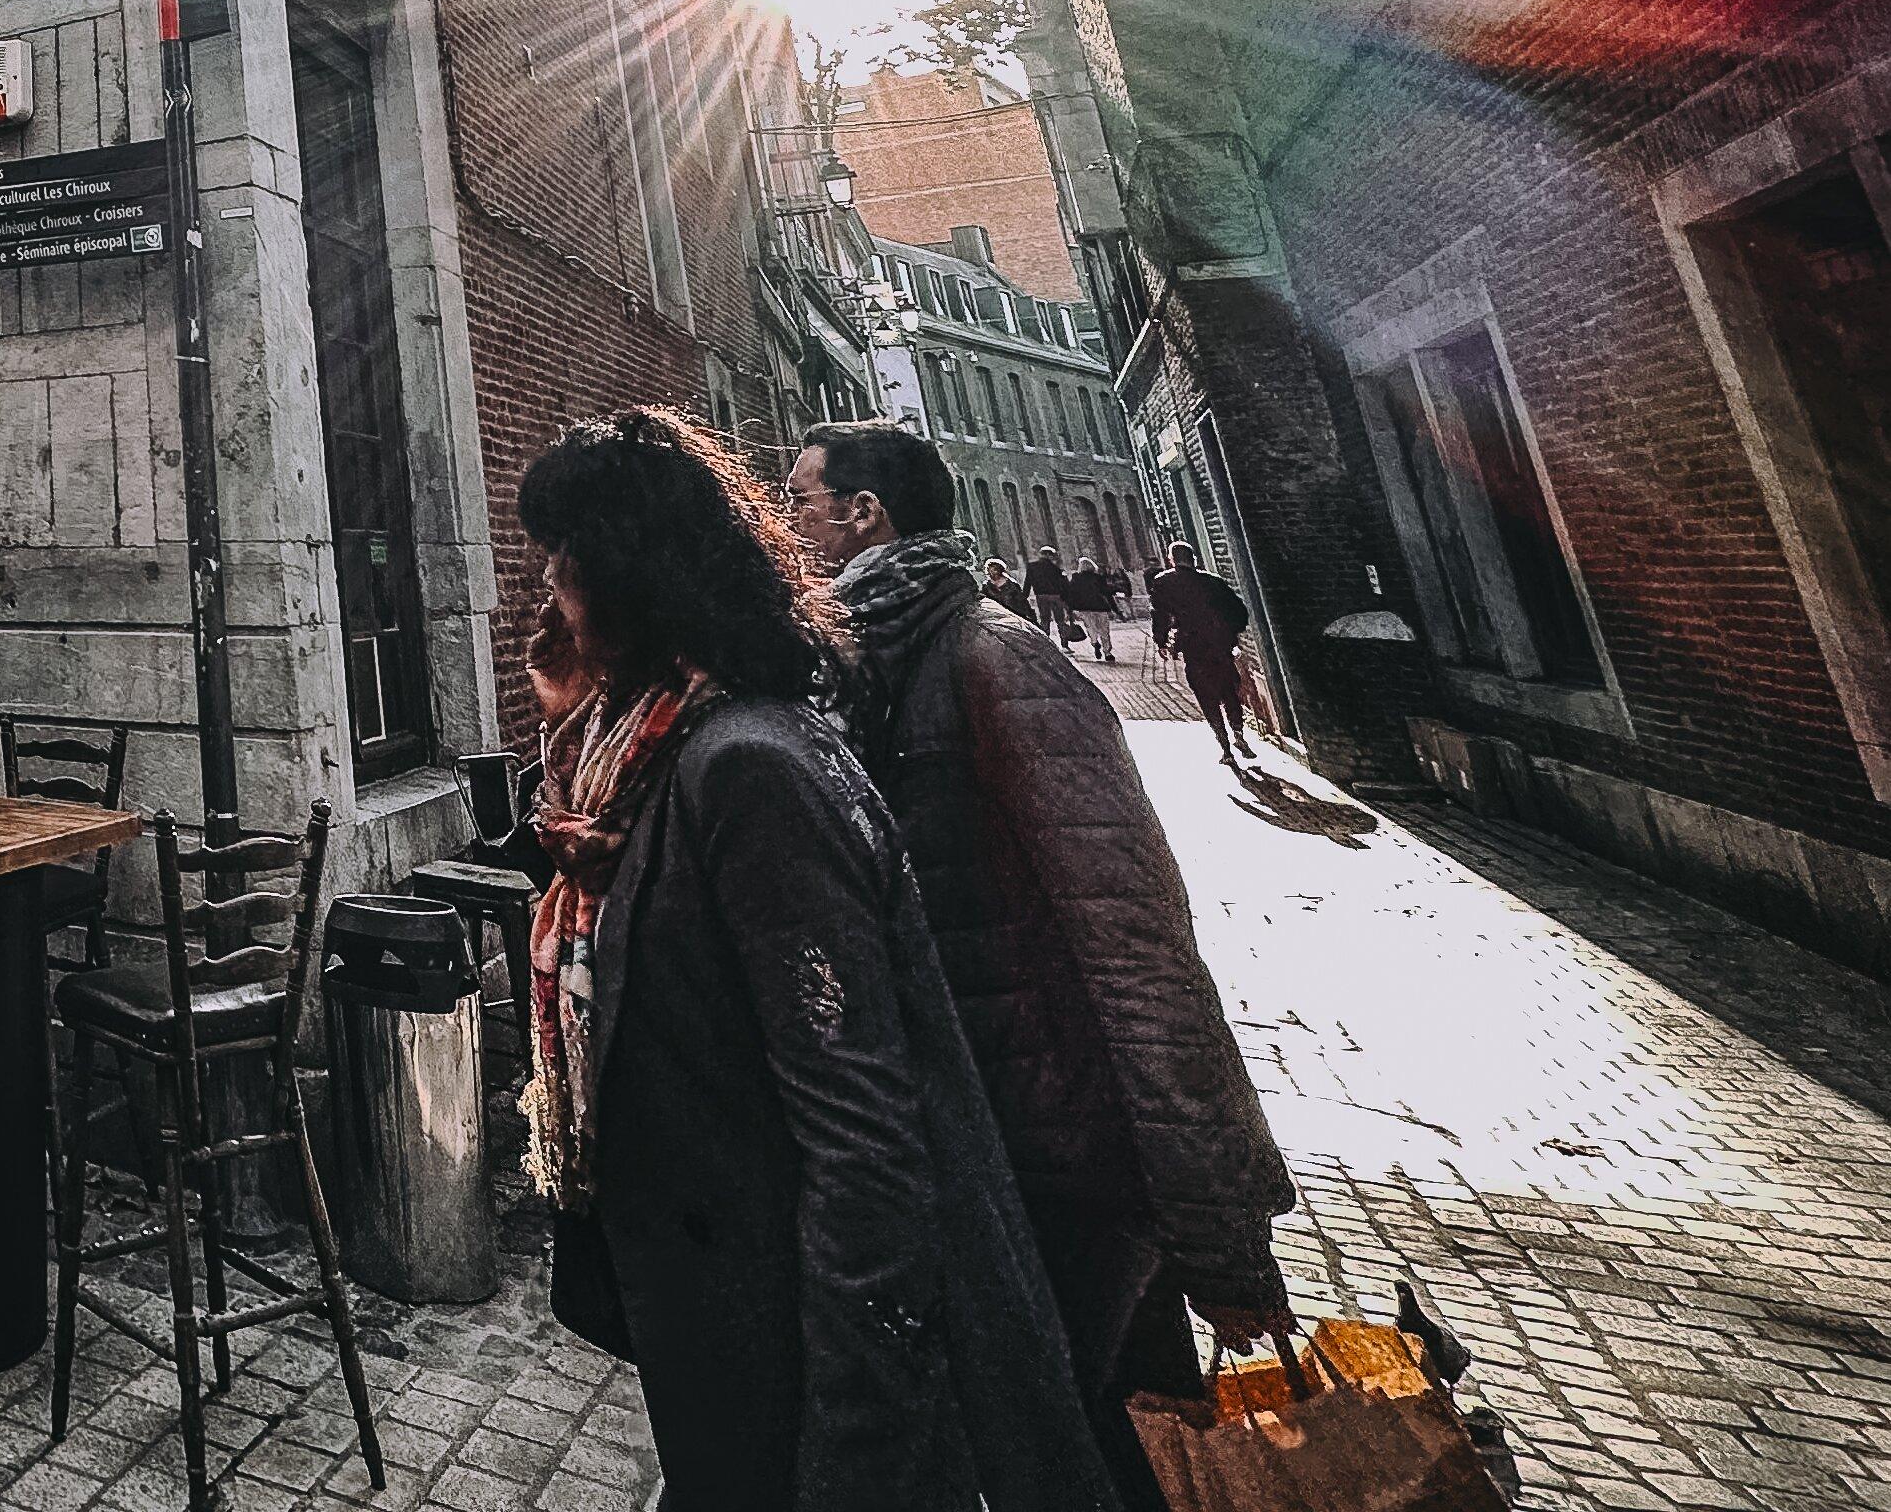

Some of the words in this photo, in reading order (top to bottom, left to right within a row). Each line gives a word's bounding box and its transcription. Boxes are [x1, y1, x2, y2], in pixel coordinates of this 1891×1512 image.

[0, 187, 42, 206] culturel
[43, 186, 63, 200] Les
[65, 180, 111, 197] Chiroux
[40, 215, 83, 230] Chiroux
[94, 203, 144, 222] Croisiers
[74, 232, 128, 256] épiscopal
